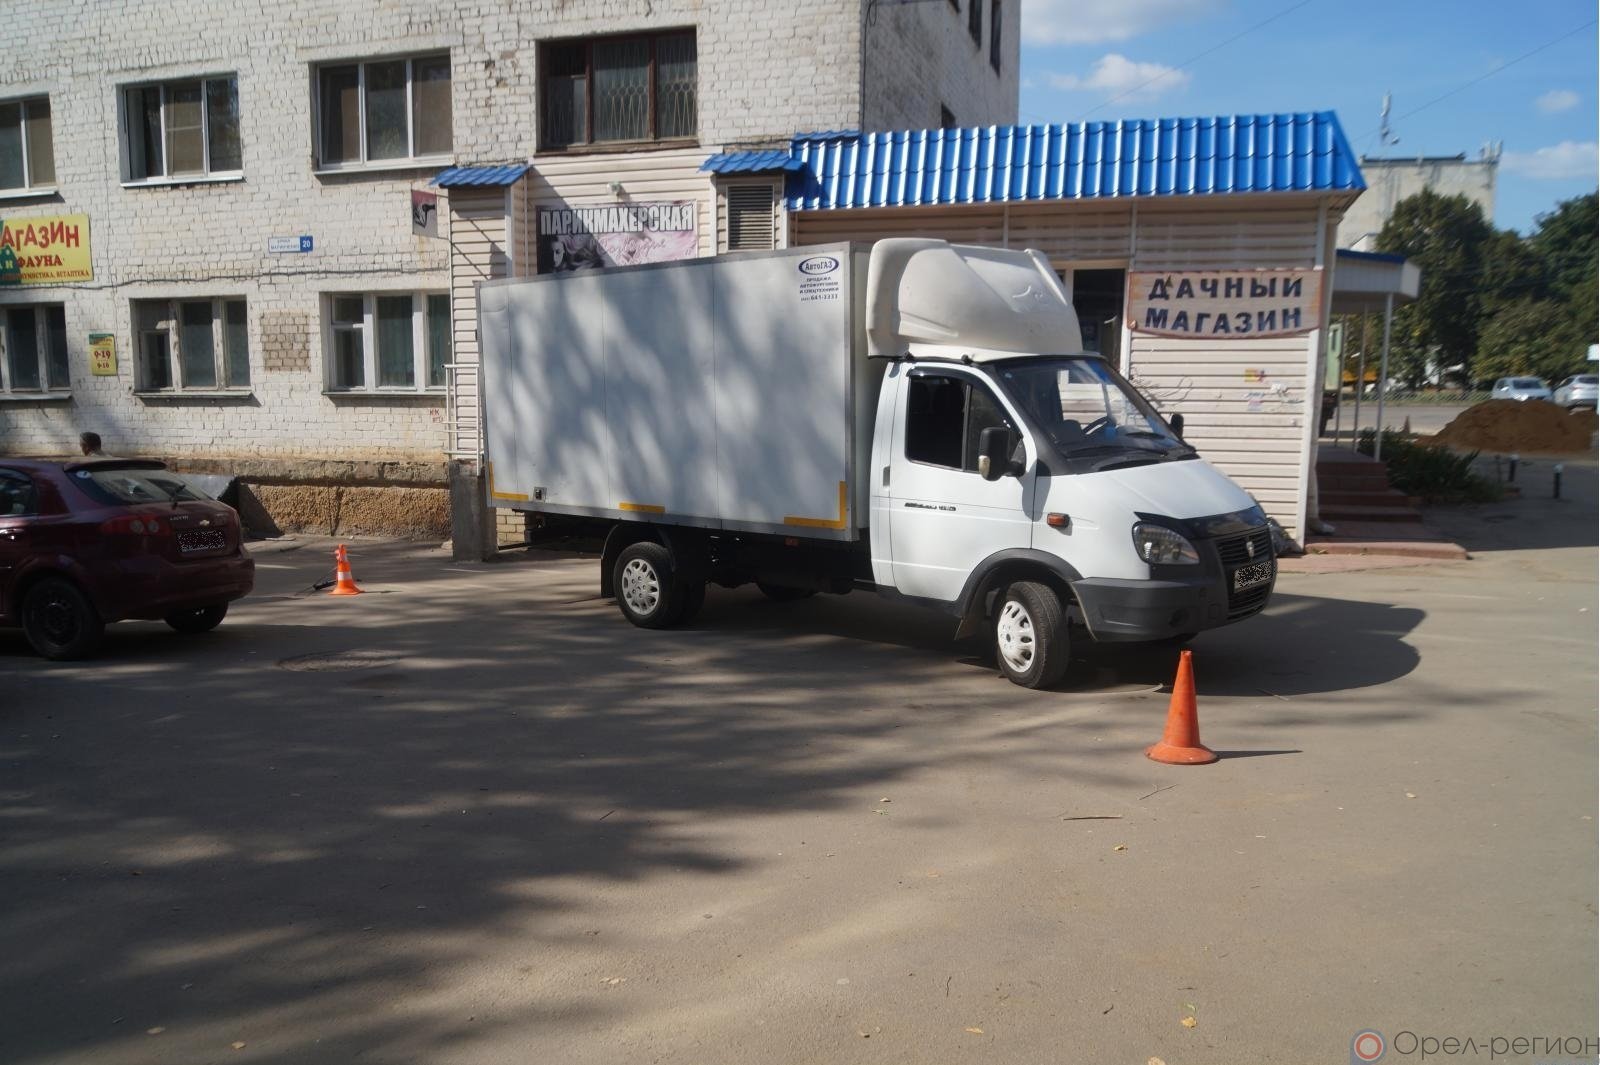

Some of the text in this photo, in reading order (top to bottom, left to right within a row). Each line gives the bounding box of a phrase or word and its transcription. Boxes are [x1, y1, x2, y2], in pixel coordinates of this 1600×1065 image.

[540, 205, 694, 235] ПАРИКМАХЕРСКАЯ
[302, 240, 311, 248] 20
[16, 255, 63, 268] ФАУНА
[1145, 307, 1302, 334] МАГАЗИН
